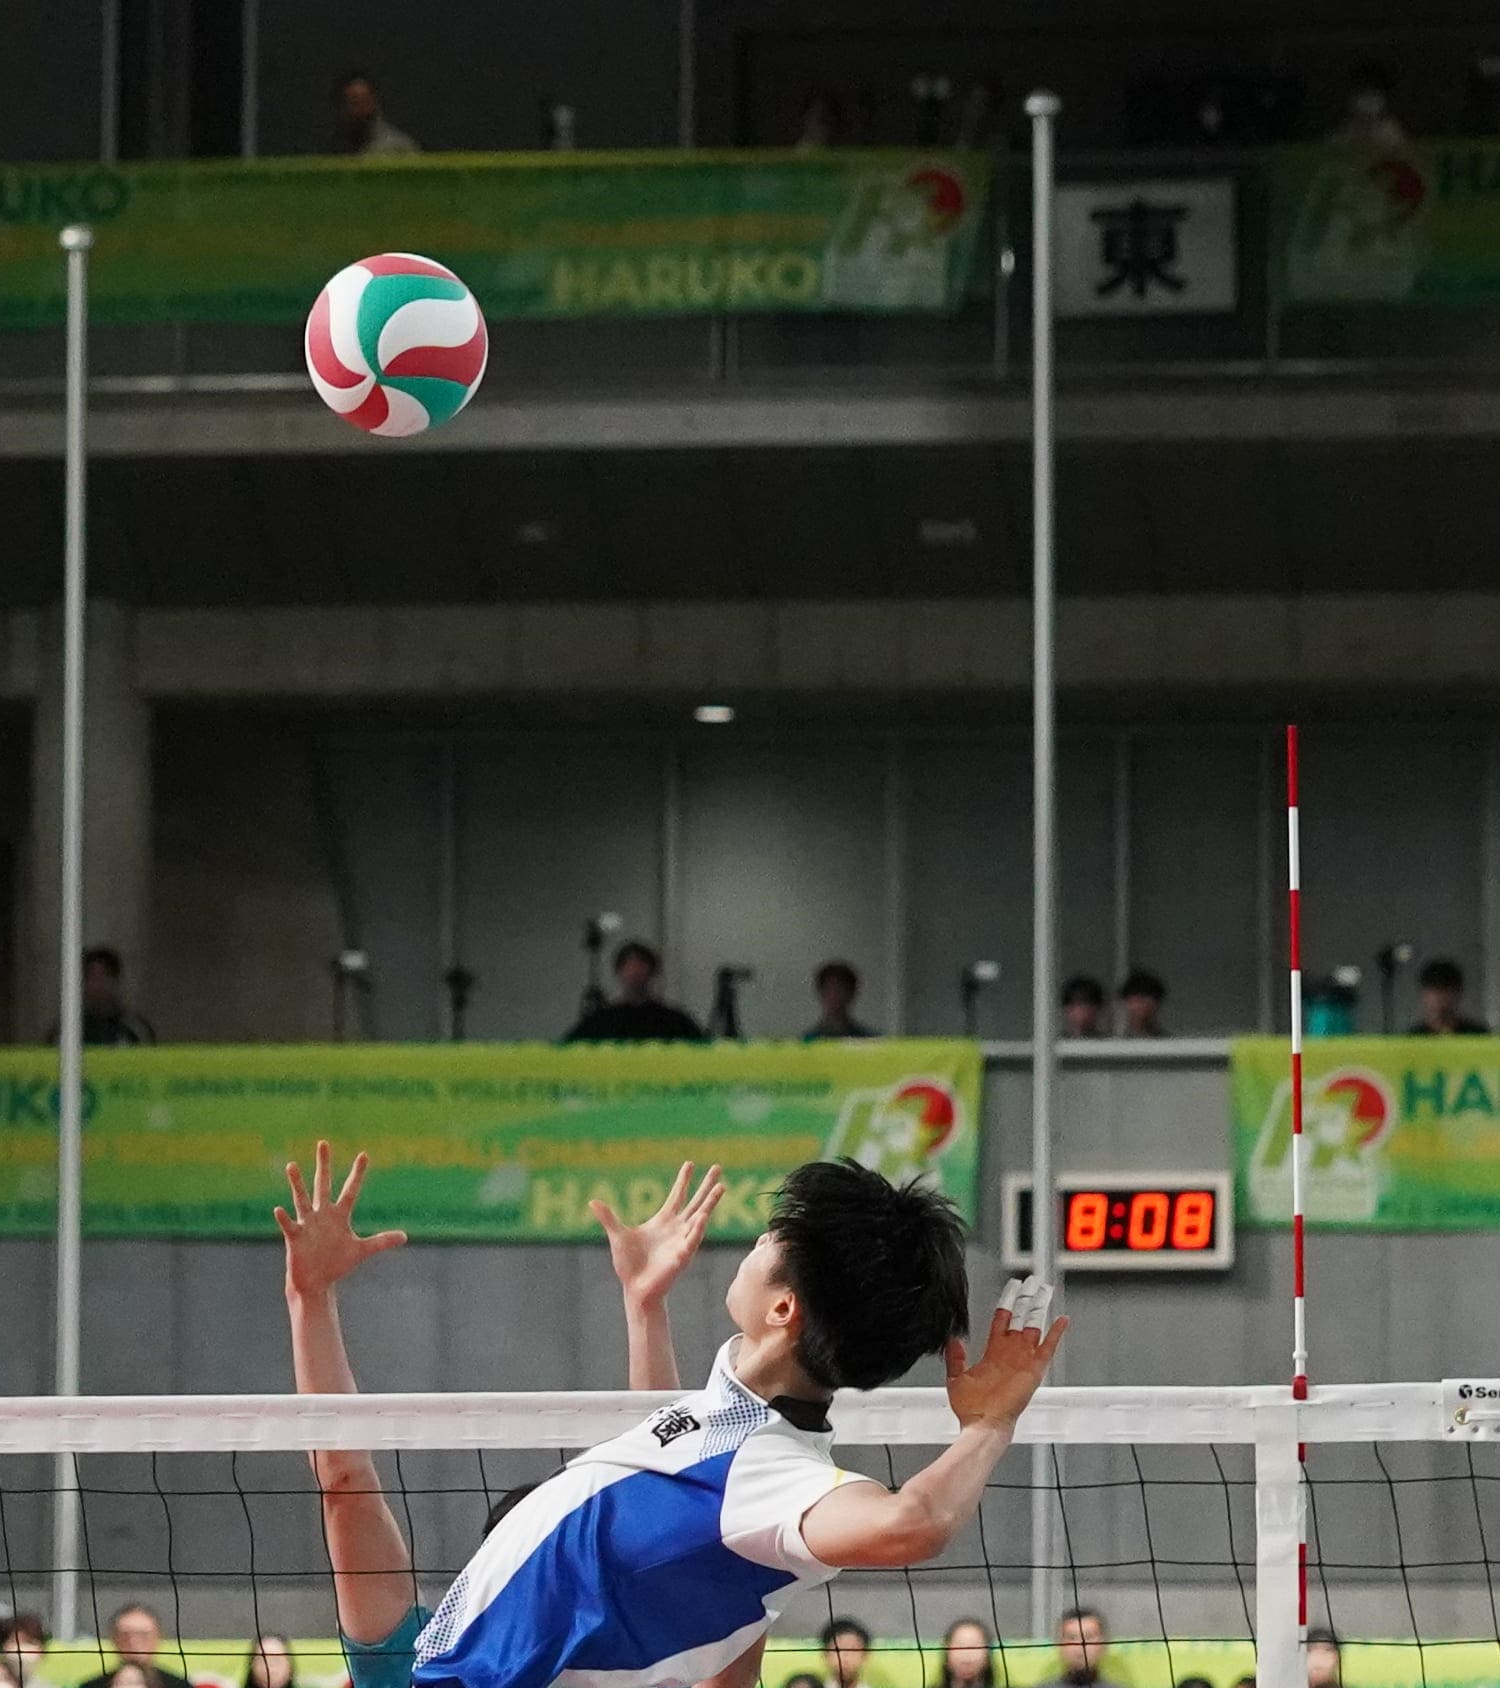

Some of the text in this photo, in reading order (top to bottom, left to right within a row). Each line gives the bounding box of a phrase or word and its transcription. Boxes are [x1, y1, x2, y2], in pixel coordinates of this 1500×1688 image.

[1092, 198, 1189, 297] 東
[550, 253, 822, 306] HARUKO
[1063, 1192, 1215, 1251] 8:08
